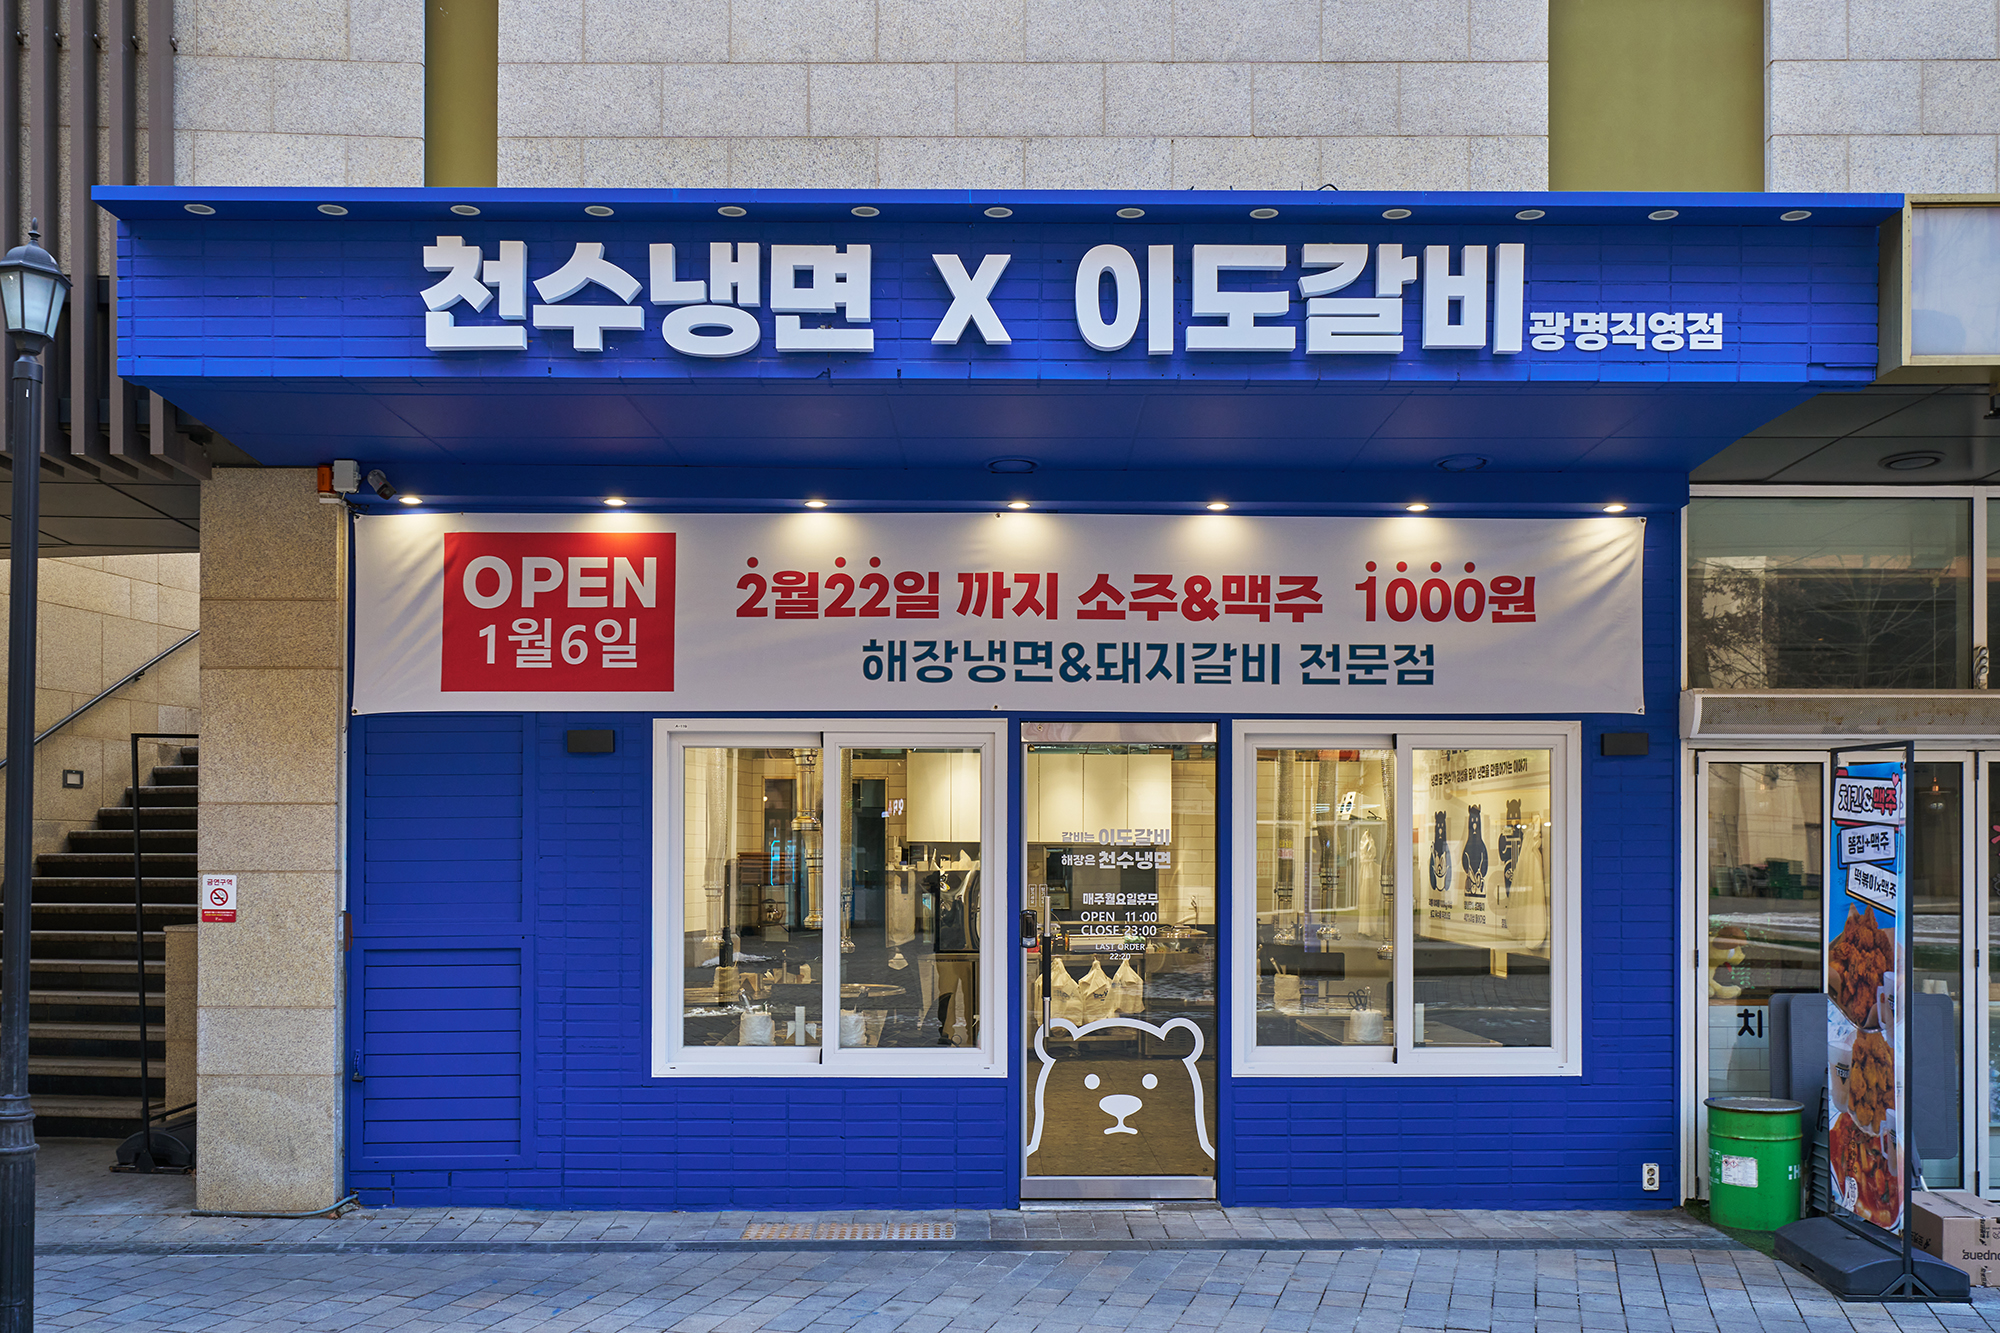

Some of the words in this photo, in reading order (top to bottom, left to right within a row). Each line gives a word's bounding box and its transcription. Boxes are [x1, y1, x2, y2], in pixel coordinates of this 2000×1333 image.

[420, 235, 875, 357] 천수냉면
[1075, 243, 1525, 355] 이도갈비
[1529, 311, 1723, 352] 광명직영점
[462, 555, 658, 608] OPEN
[736, 556, 940, 619] 2월22일
[957, 571, 1059, 620] 까지
[1077, 572, 1324, 623] 소주&맥주
[1354, 560, 1537, 623] 1000원
[478, 616, 638, 669] 1월6일
[862, 638, 1281, 686] 해장냉면&돼지갈비
[1299, 643, 1436, 686] 전문점
[1838, 784, 1897, 816] 치킨&맥주
[1061, 831, 1095, 843] 갈비는
[1099, 828, 1170, 846] 이도갈비
[1061, 854, 1096, 866] 해장은
[1098, 850, 1171, 870] 천수냉면
[207, 878, 233, 886] 금연구역
[1082, 892, 1159, 906] 매주월요일휴무
[1080, 911, 1115, 922] OPEN
[1081, 925, 1120, 936] CLOSE
[1124, 925, 1157, 936] 23:00
[1117, 943, 1146, 951] ORDER
